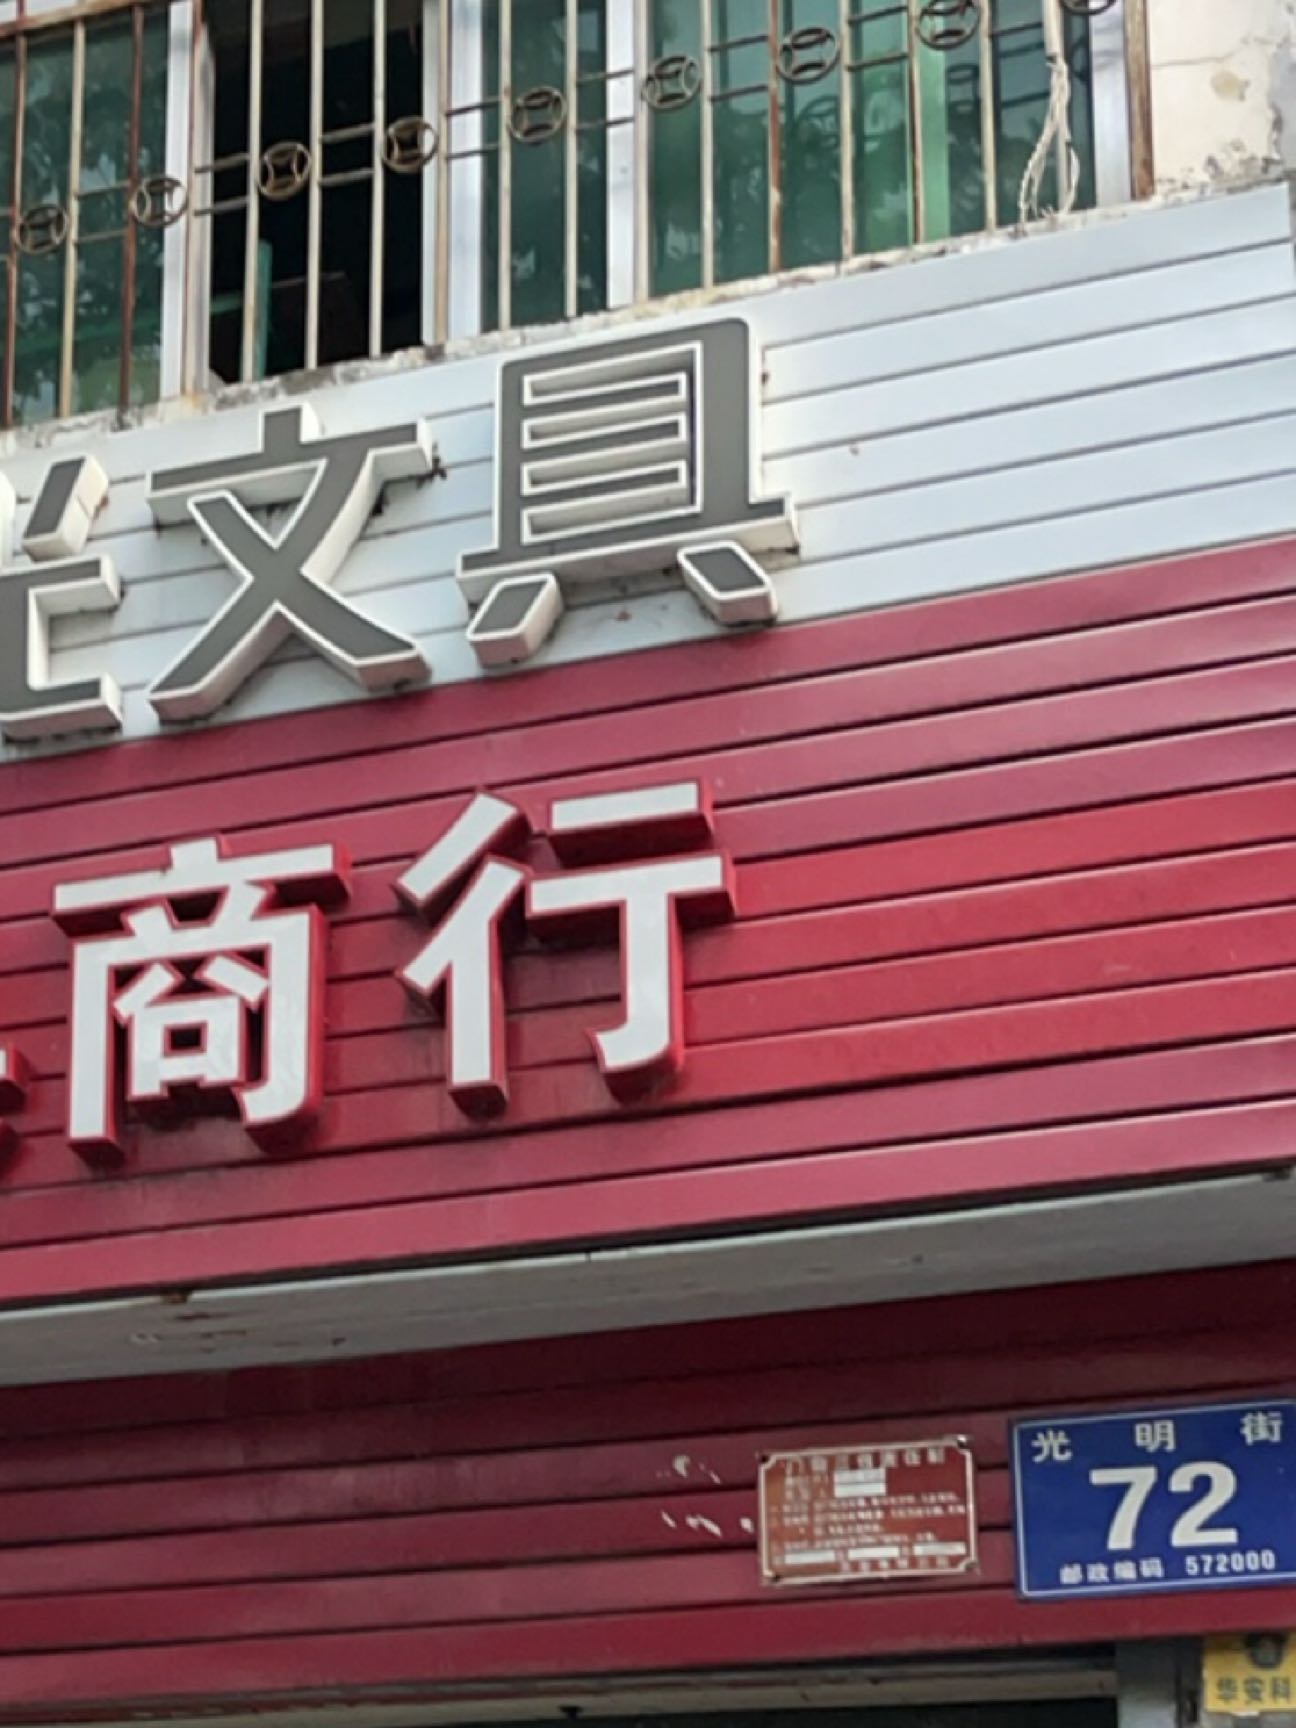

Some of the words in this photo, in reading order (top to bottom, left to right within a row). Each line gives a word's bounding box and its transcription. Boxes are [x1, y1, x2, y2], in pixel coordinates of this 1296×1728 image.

[1031, 1412, 1282, 1463] 光明街
[1090, 1461, 1238, 1550] 72
[1060, 1556, 1164, 1584] 邮政编码
[1185, 1549, 1275, 1575] 572000
